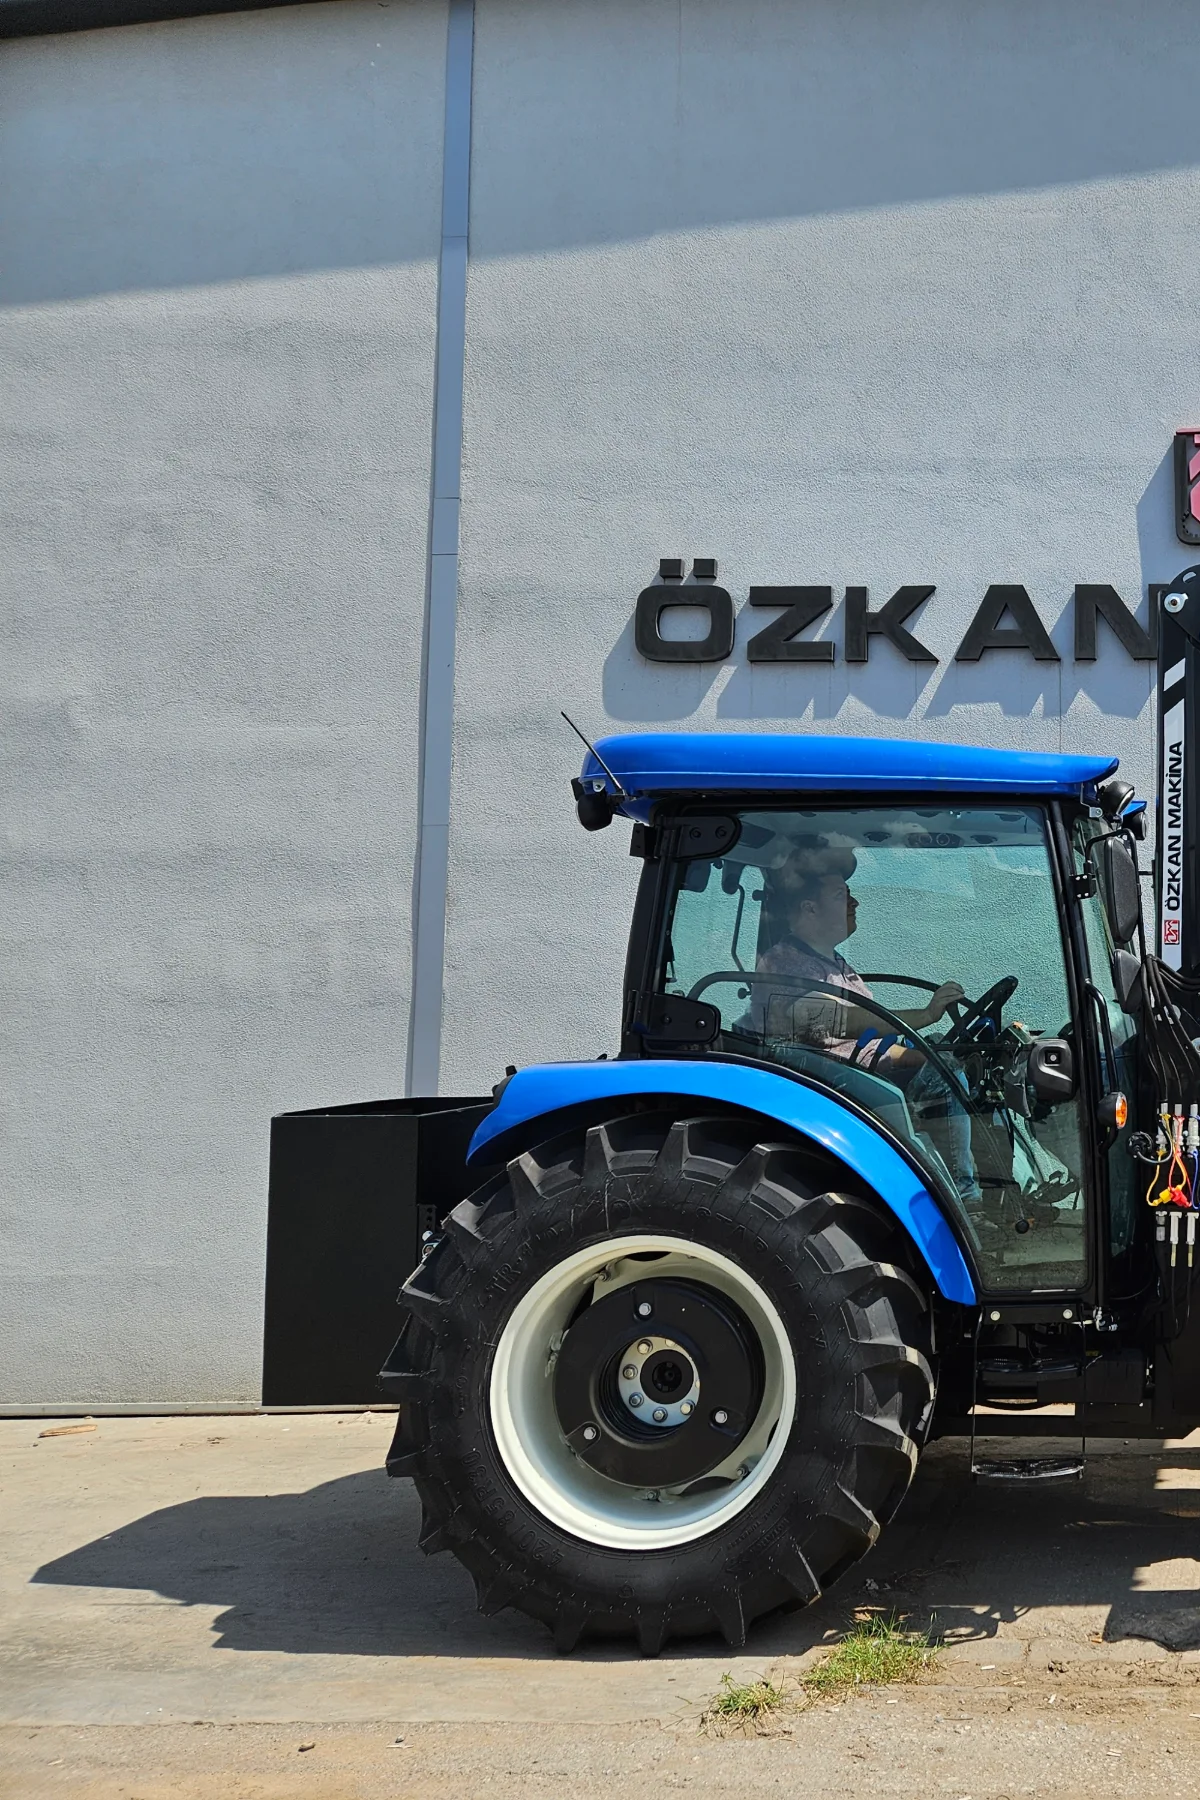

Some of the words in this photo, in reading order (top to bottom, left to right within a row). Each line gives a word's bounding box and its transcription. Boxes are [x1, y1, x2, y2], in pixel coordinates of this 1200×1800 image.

[634, 558, 1169, 662] ÖZKAN
[1165, 741, 1182, 828] MAKİNA
[1164, 835, 1181, 911] ÖZKAN
